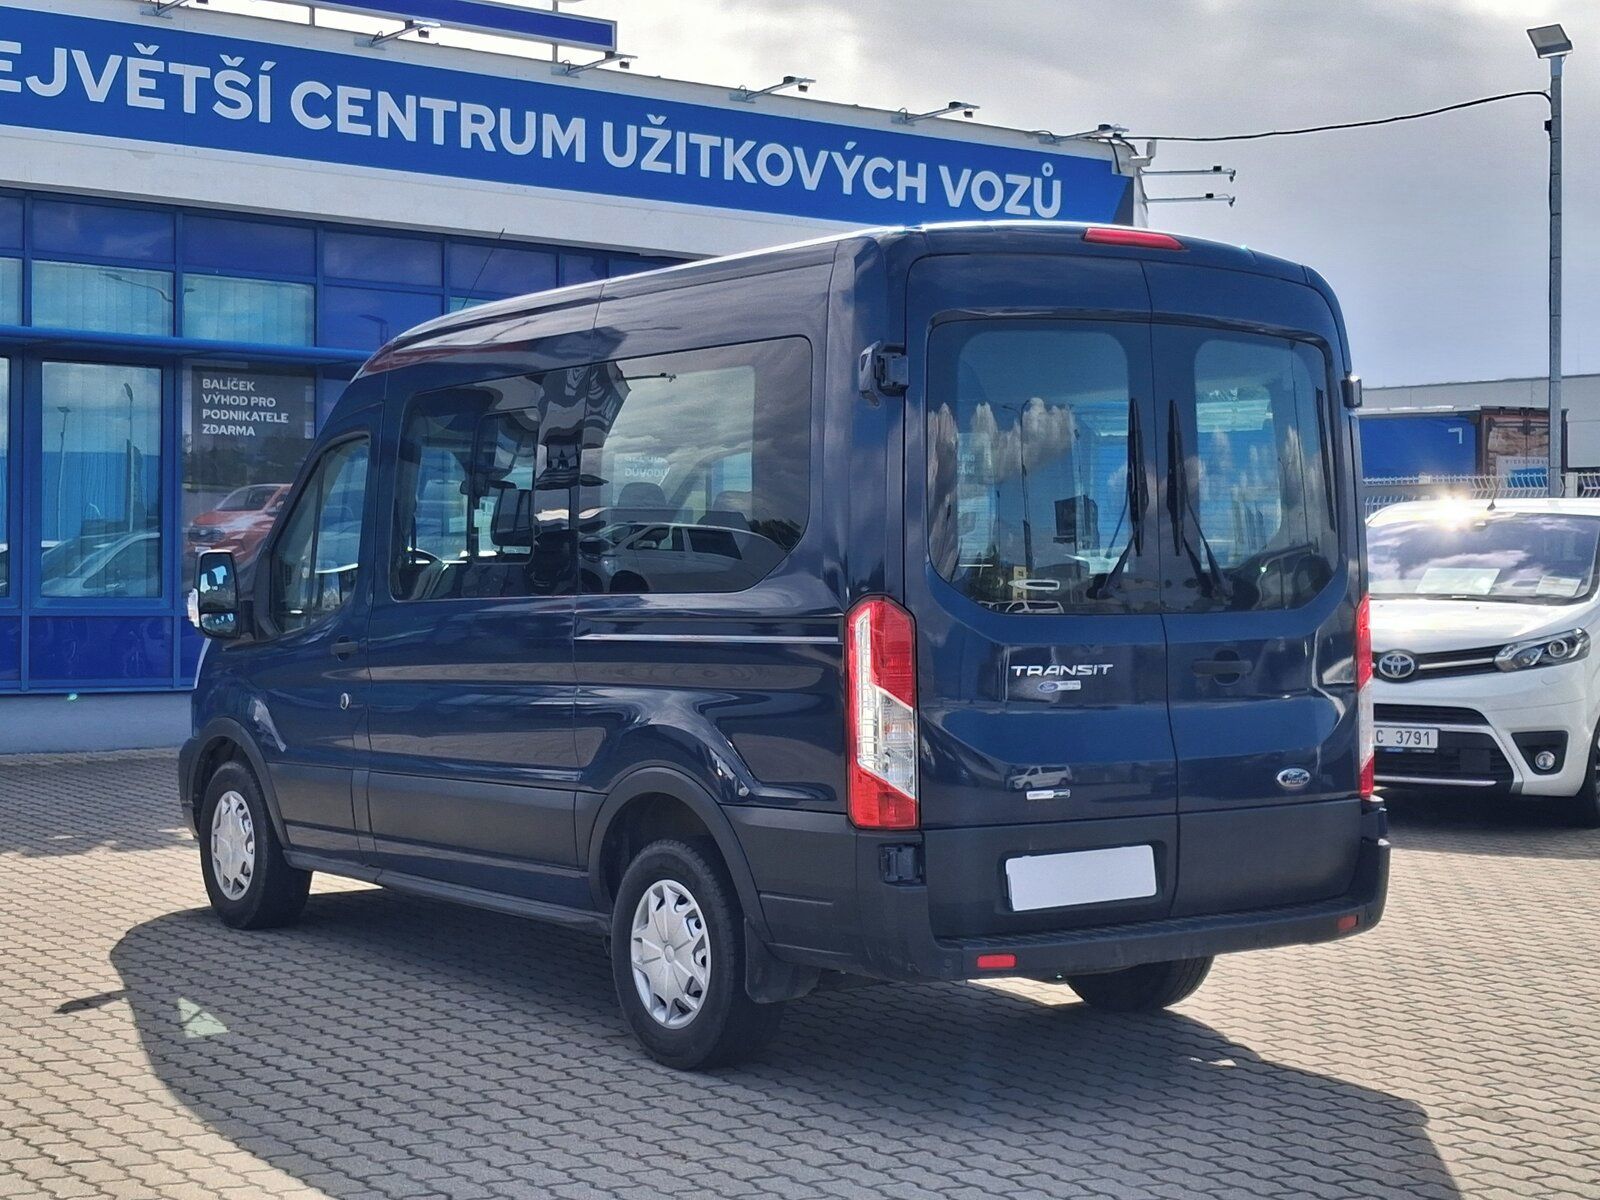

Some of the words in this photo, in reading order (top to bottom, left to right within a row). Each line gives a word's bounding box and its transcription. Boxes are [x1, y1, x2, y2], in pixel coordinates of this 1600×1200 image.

[290, 80, 586, 163] CENTRUM
[602, 114, 927, 204] UŽITKOVÝCH
[939, 162, 1061, 219] VOZŮ
[202, 377, 255, 391] BALÍČEK
[202, 391, 248, 406] VÝHOD
[250, 396, 276, 408] PRO
[202, 409, 289, 424] PODNIKATELE
[202, 423, 255, 436] ZDARMA
[1010, 663, 1114, 677] TRANSIT
[1395, 730, 1430, 746] 3791
